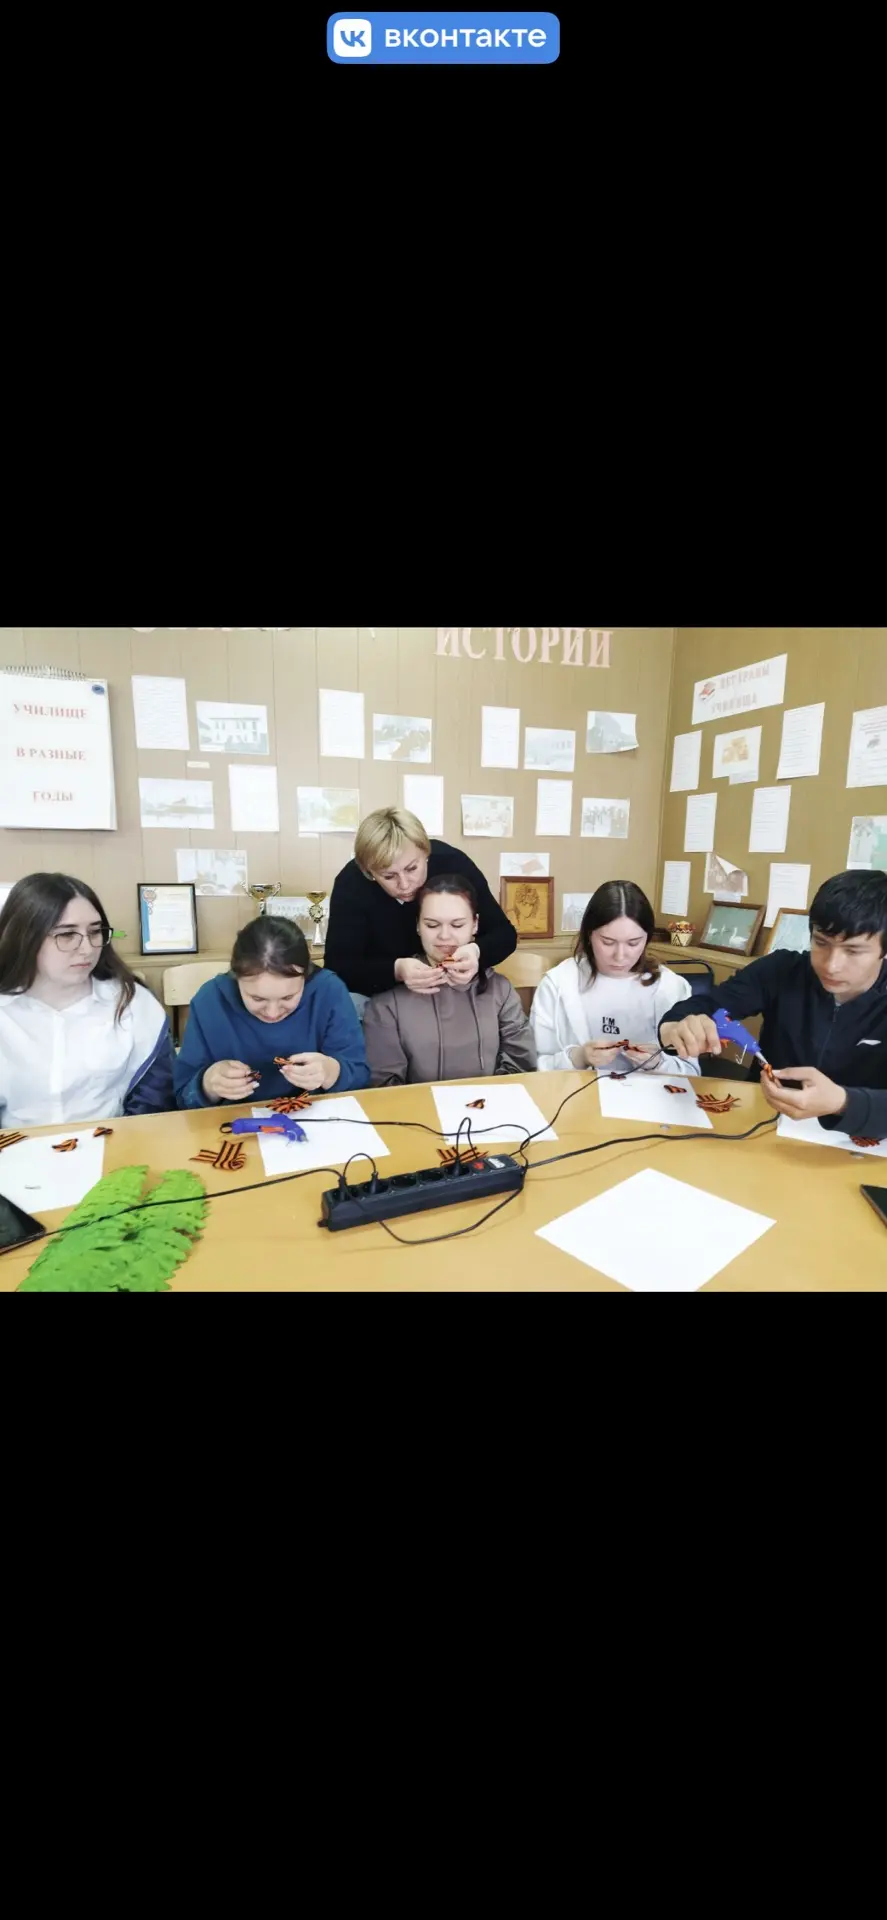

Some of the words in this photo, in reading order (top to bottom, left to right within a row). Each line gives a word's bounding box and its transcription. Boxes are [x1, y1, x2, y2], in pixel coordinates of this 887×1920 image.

[434, 628, 613, 668] ИСТОРИИ
[13, 703, 88, 719] УЧИЛИЩЕ
[16, 746, 25, 758] В
[29, 748, 86, 761] РАЗНЫЕ
[33, 790, 73, 803] ГОДЫ
[602, 1016, 615, 1026] I'M
[603, 1025, 618, 1034] OK
